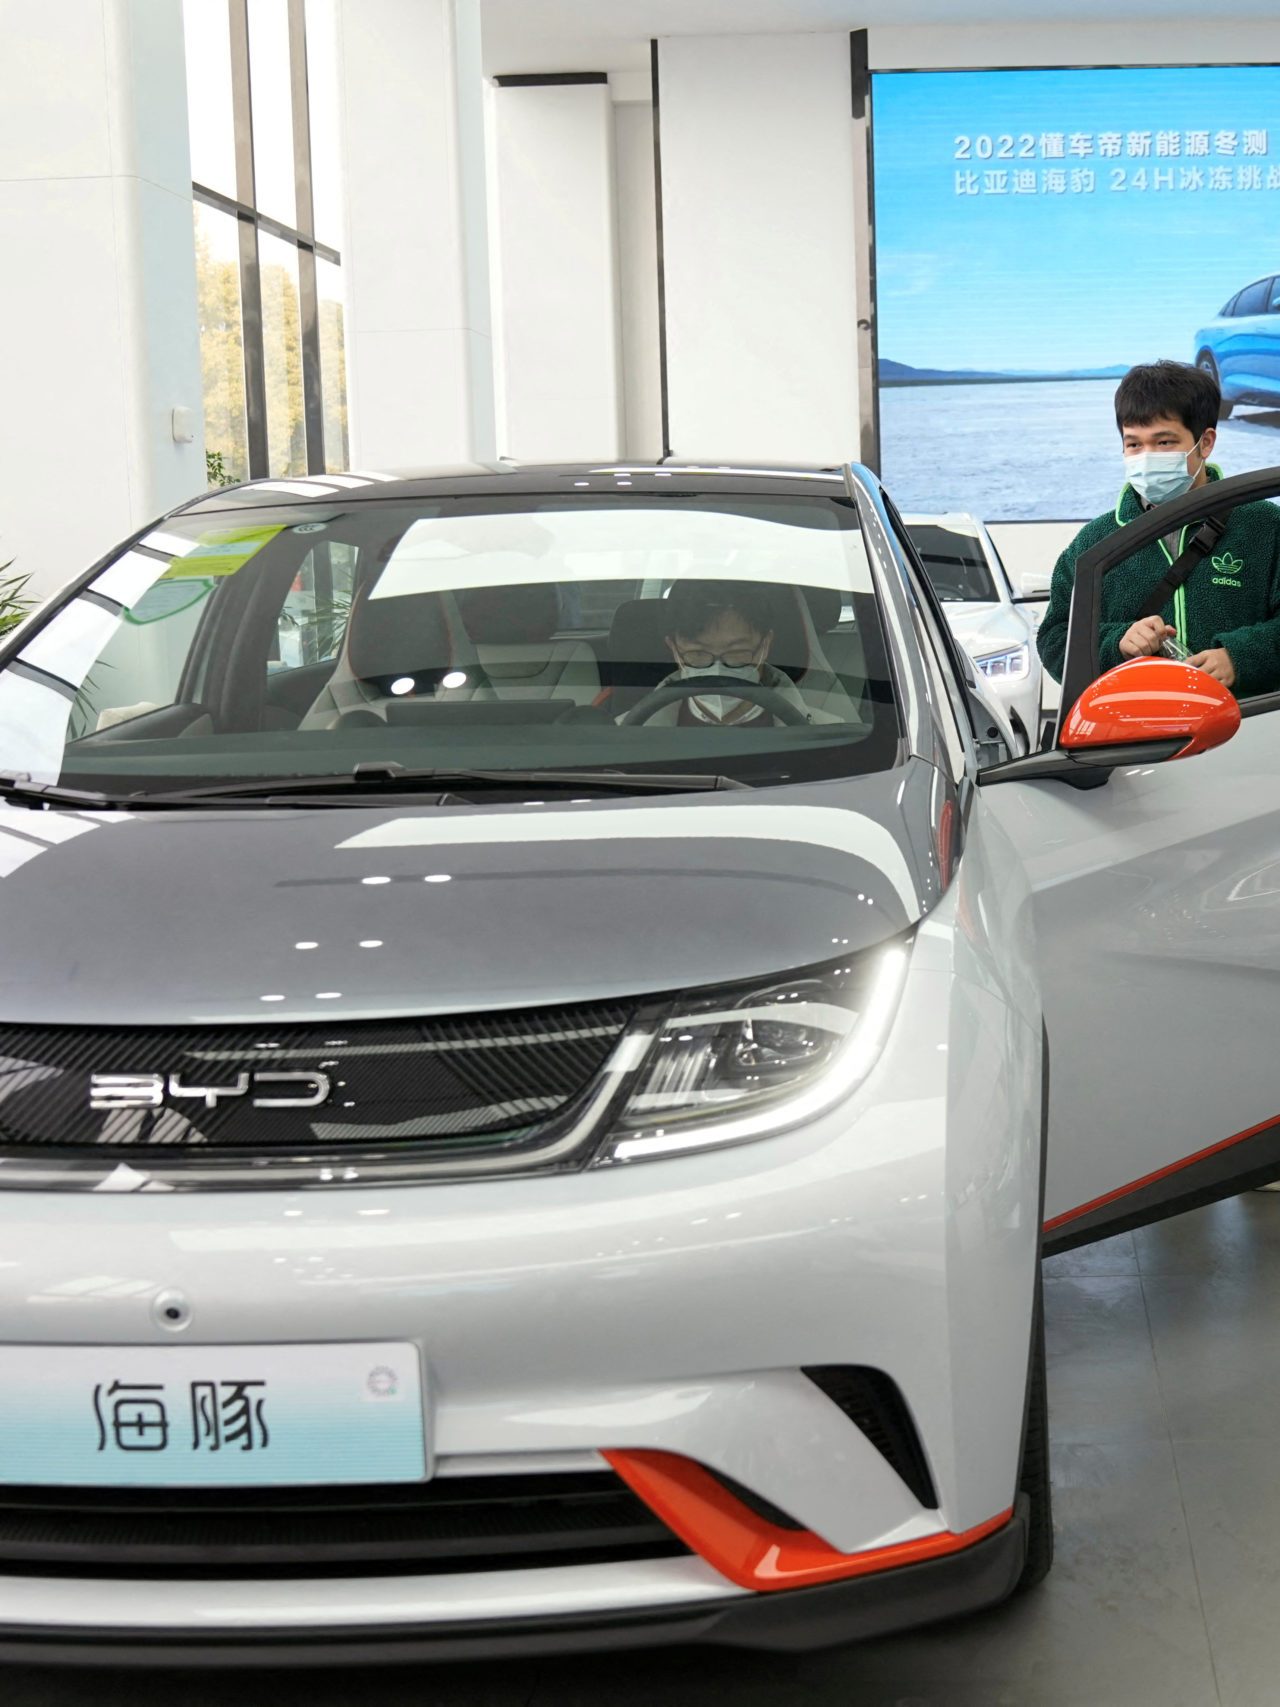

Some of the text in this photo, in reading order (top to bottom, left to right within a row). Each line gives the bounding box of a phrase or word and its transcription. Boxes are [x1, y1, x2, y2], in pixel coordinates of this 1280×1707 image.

[953, 129, 1269, 160] 2022懂车帝新能源冬测
[954, 168, 1097, 196] 比亚迪海豹
[1212, 577, 1242, 588] adidas
[90, 1071, 330, 1110] BYD
[92, 1379, 269, 1452] 海豚
